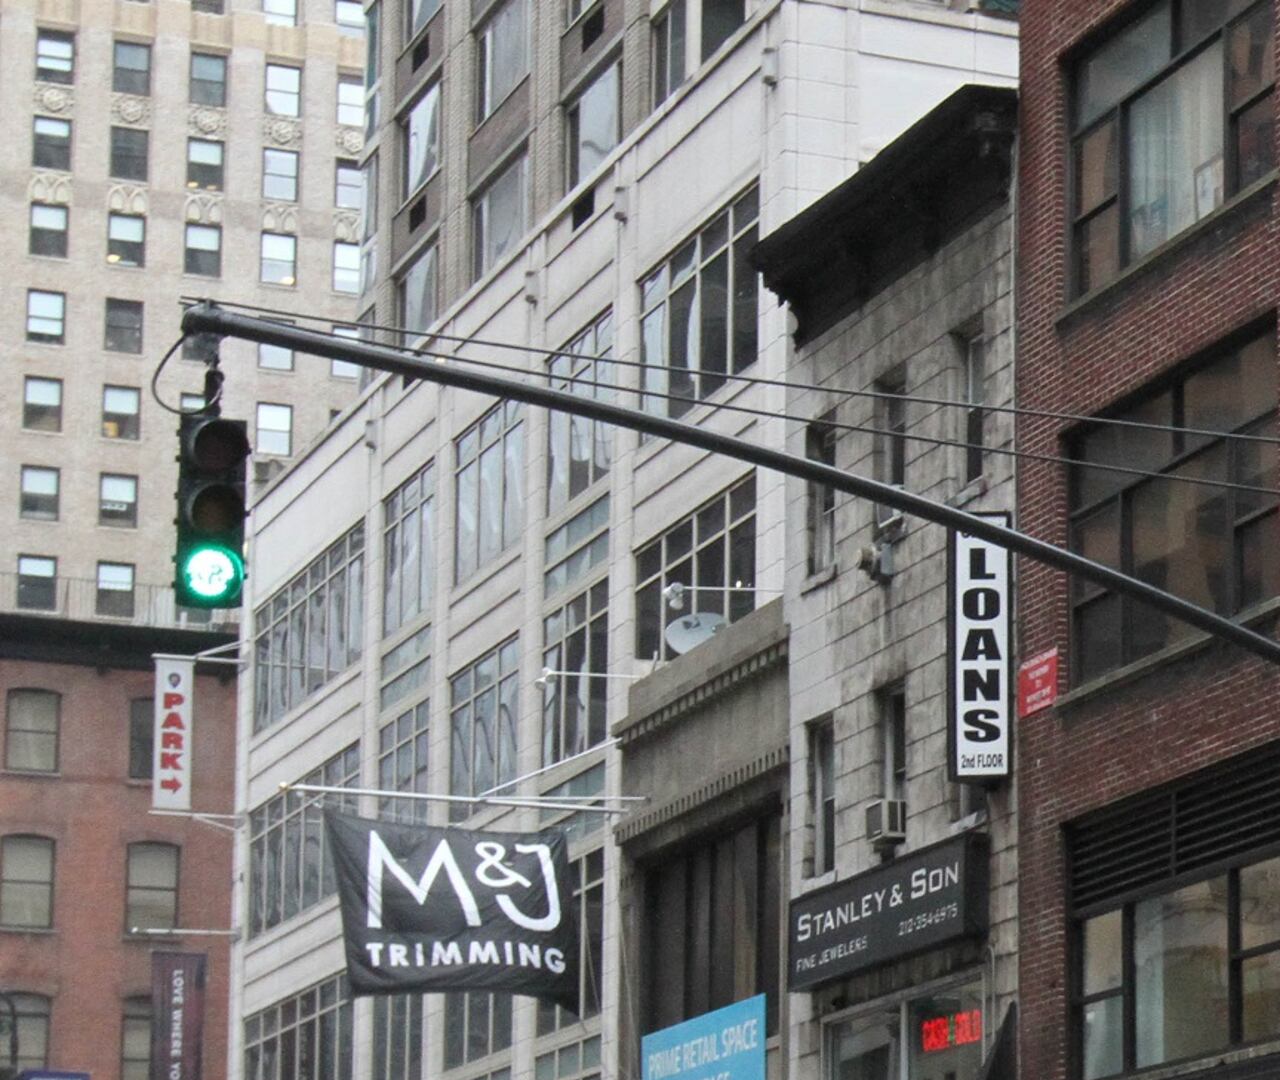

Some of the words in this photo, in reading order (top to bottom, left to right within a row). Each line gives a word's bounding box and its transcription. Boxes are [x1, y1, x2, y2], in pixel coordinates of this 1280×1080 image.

[961, 547, 1002, 743] LOANS
[160, 692, 186, 771] PARK
[961, 755, 976, 769] 2nd
[977, 753, 1004, 768] FLOOR
[367, 829, 561, 932] M&J
[889, 883, 904, 908] &
[365, 940, 566, 975] TRIMMING
[795, 953, 817, 973] FINE
[818, 935, 869, 965] JEWELERS
[172, 969, 184, 1004] LOVE
[170, 1009, 183, 1057] WHERE
[682, 1032, 720, 1071] RETAIL
[721, 1018, 759, 1058] SPACE
